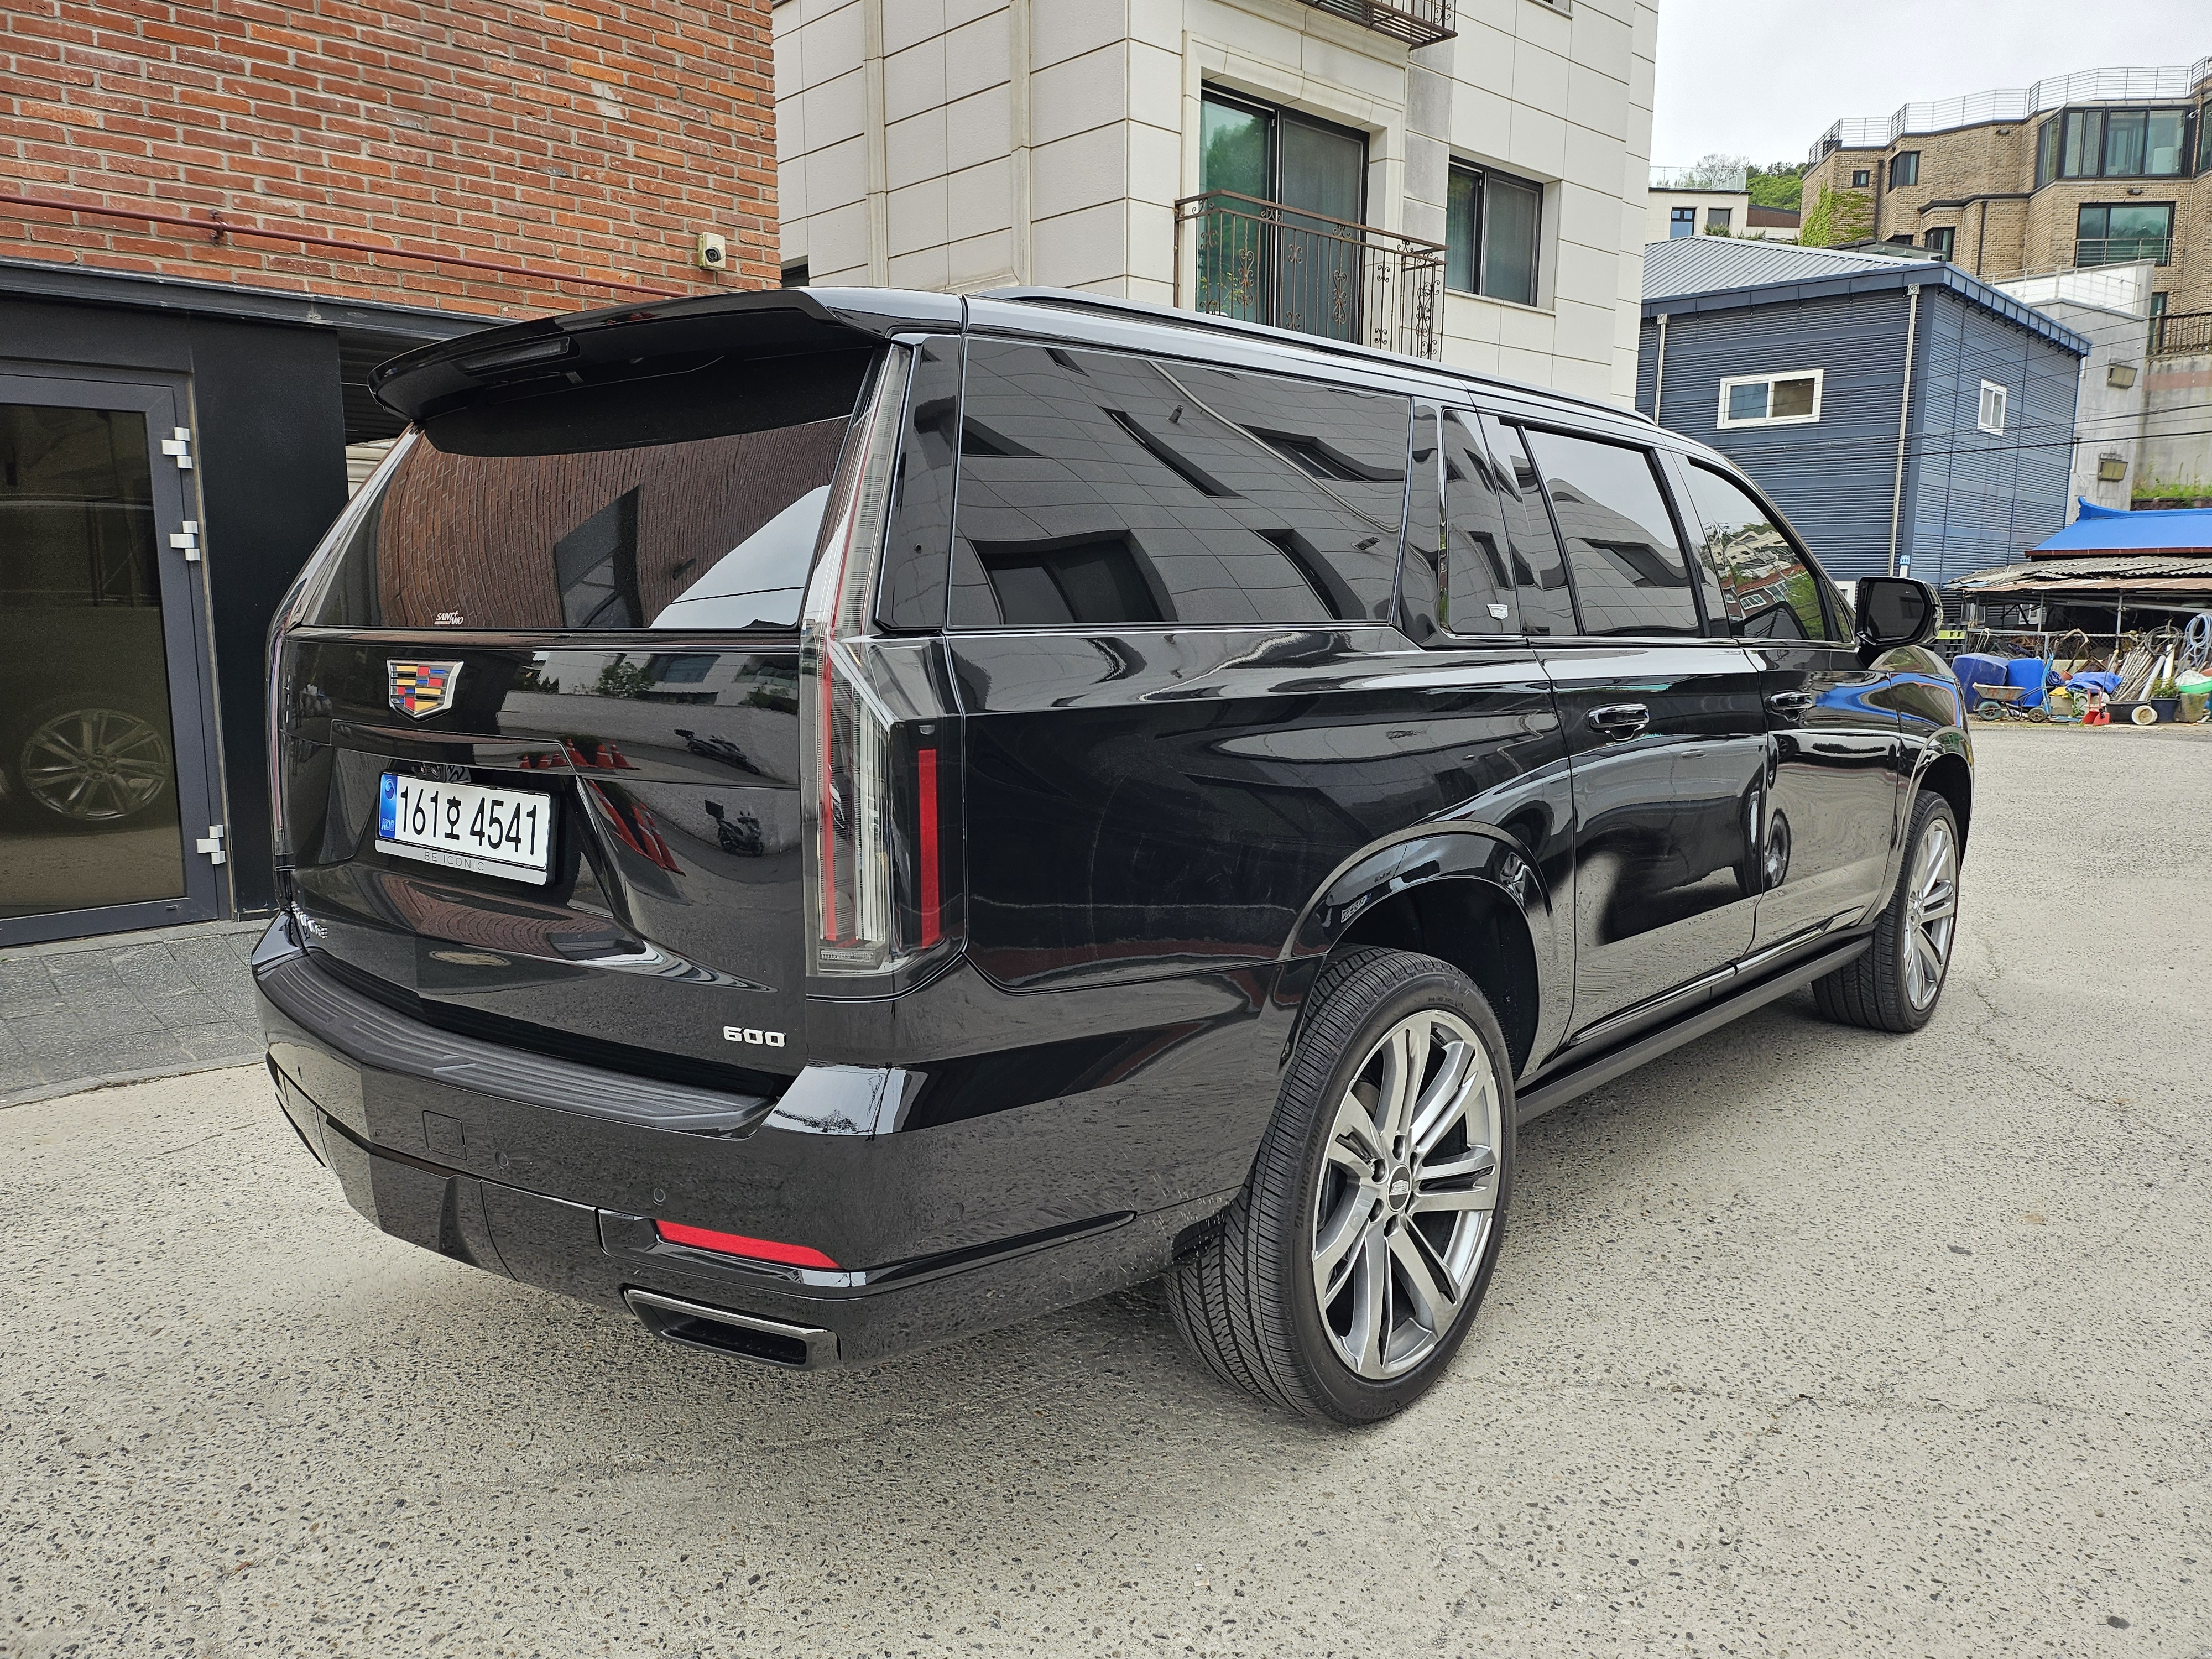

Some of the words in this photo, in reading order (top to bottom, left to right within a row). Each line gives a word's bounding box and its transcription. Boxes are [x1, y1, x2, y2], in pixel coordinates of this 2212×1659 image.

[381, 818, 395, 832] KOR
[400, 786, 461, 841] 161호
[470, 797, 536, 855] 4541
[424, 851, 437, 862] BE
[444, 852, 484, 871] ICONIC
[723, 1026, 786, 1047] 600
[1295, 1114, 1326, 1229] BRIDGESTONE
